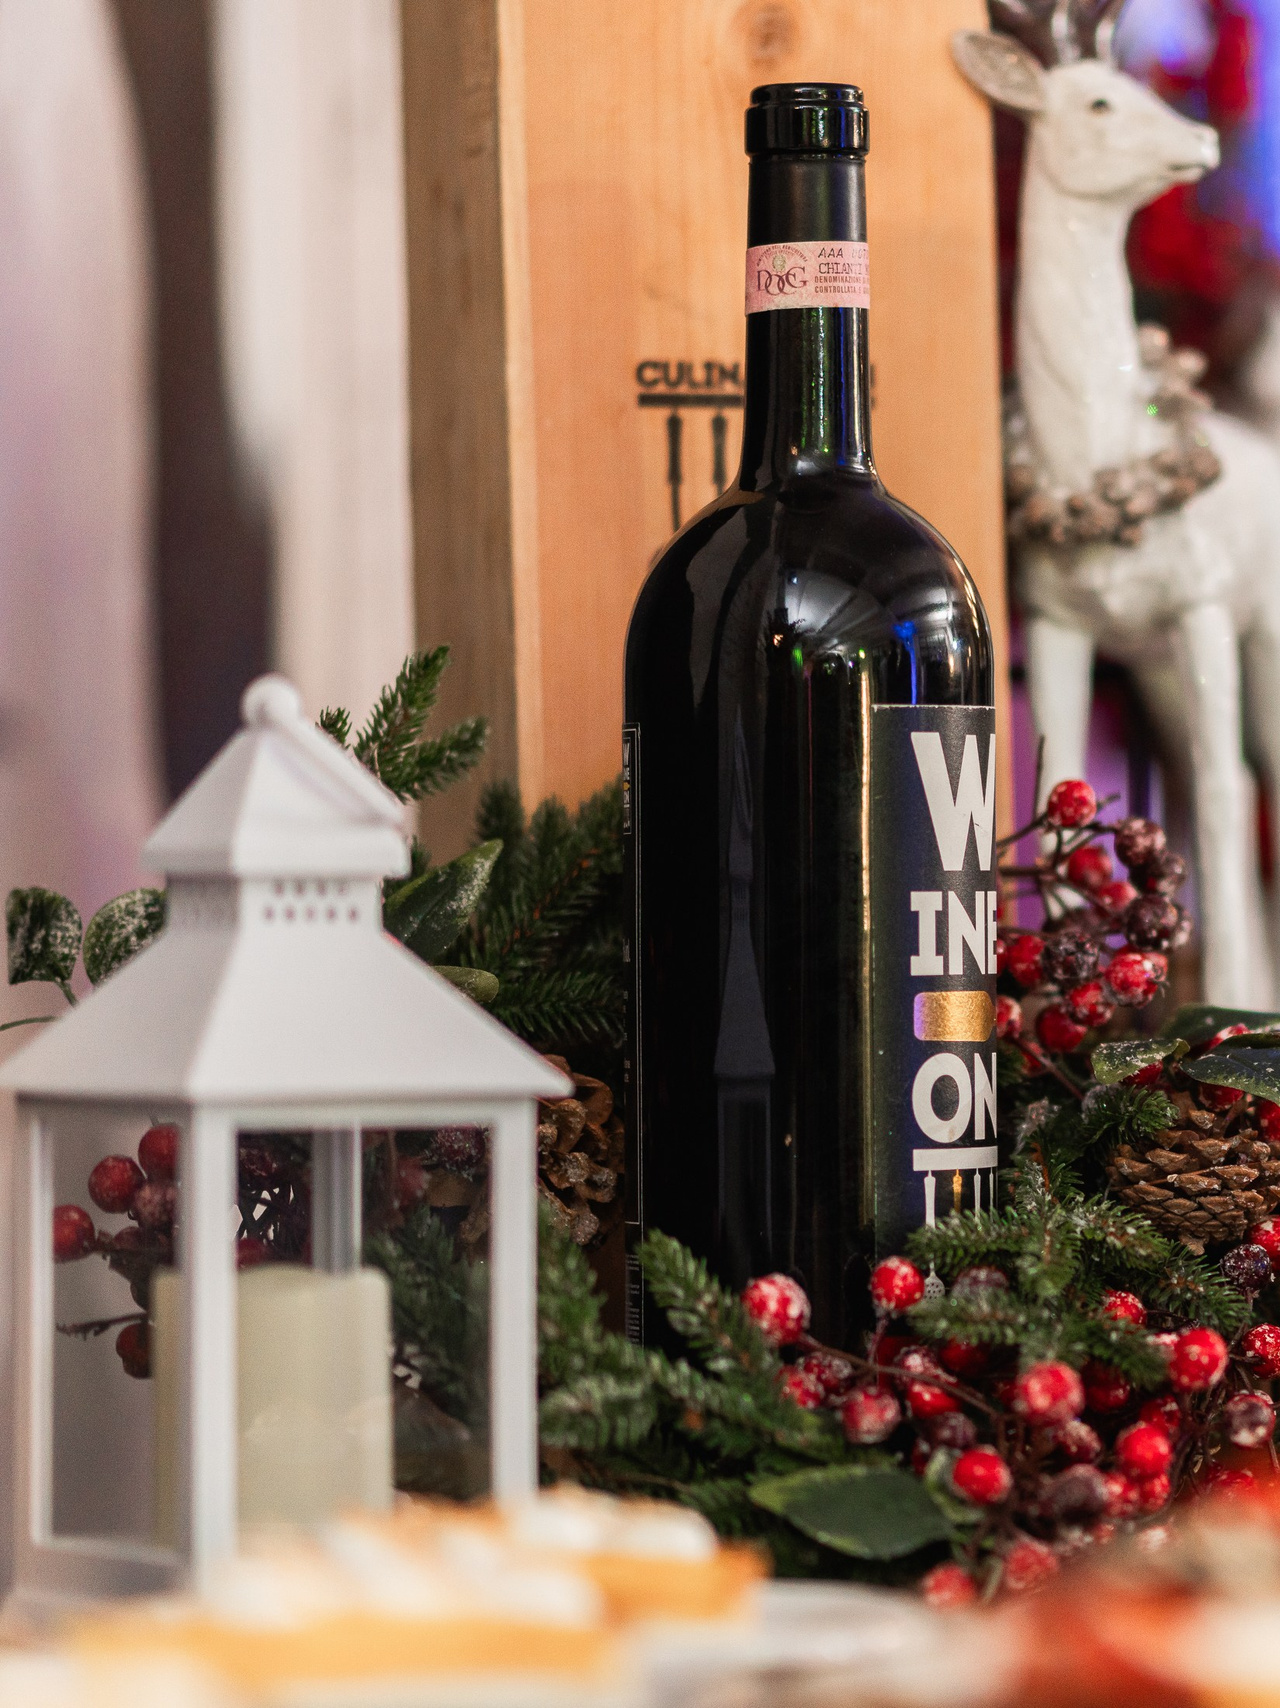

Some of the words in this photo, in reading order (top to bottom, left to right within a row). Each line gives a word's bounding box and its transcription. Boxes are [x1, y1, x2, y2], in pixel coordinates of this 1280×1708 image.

[817, 247, 844, 259] AAA
[818, 262, 863, 275] CHIANTI
[636, 360, 745, 389] CULIN
[910, 731, 996, 871] W
[912, 1052, 997, 1144] ON
